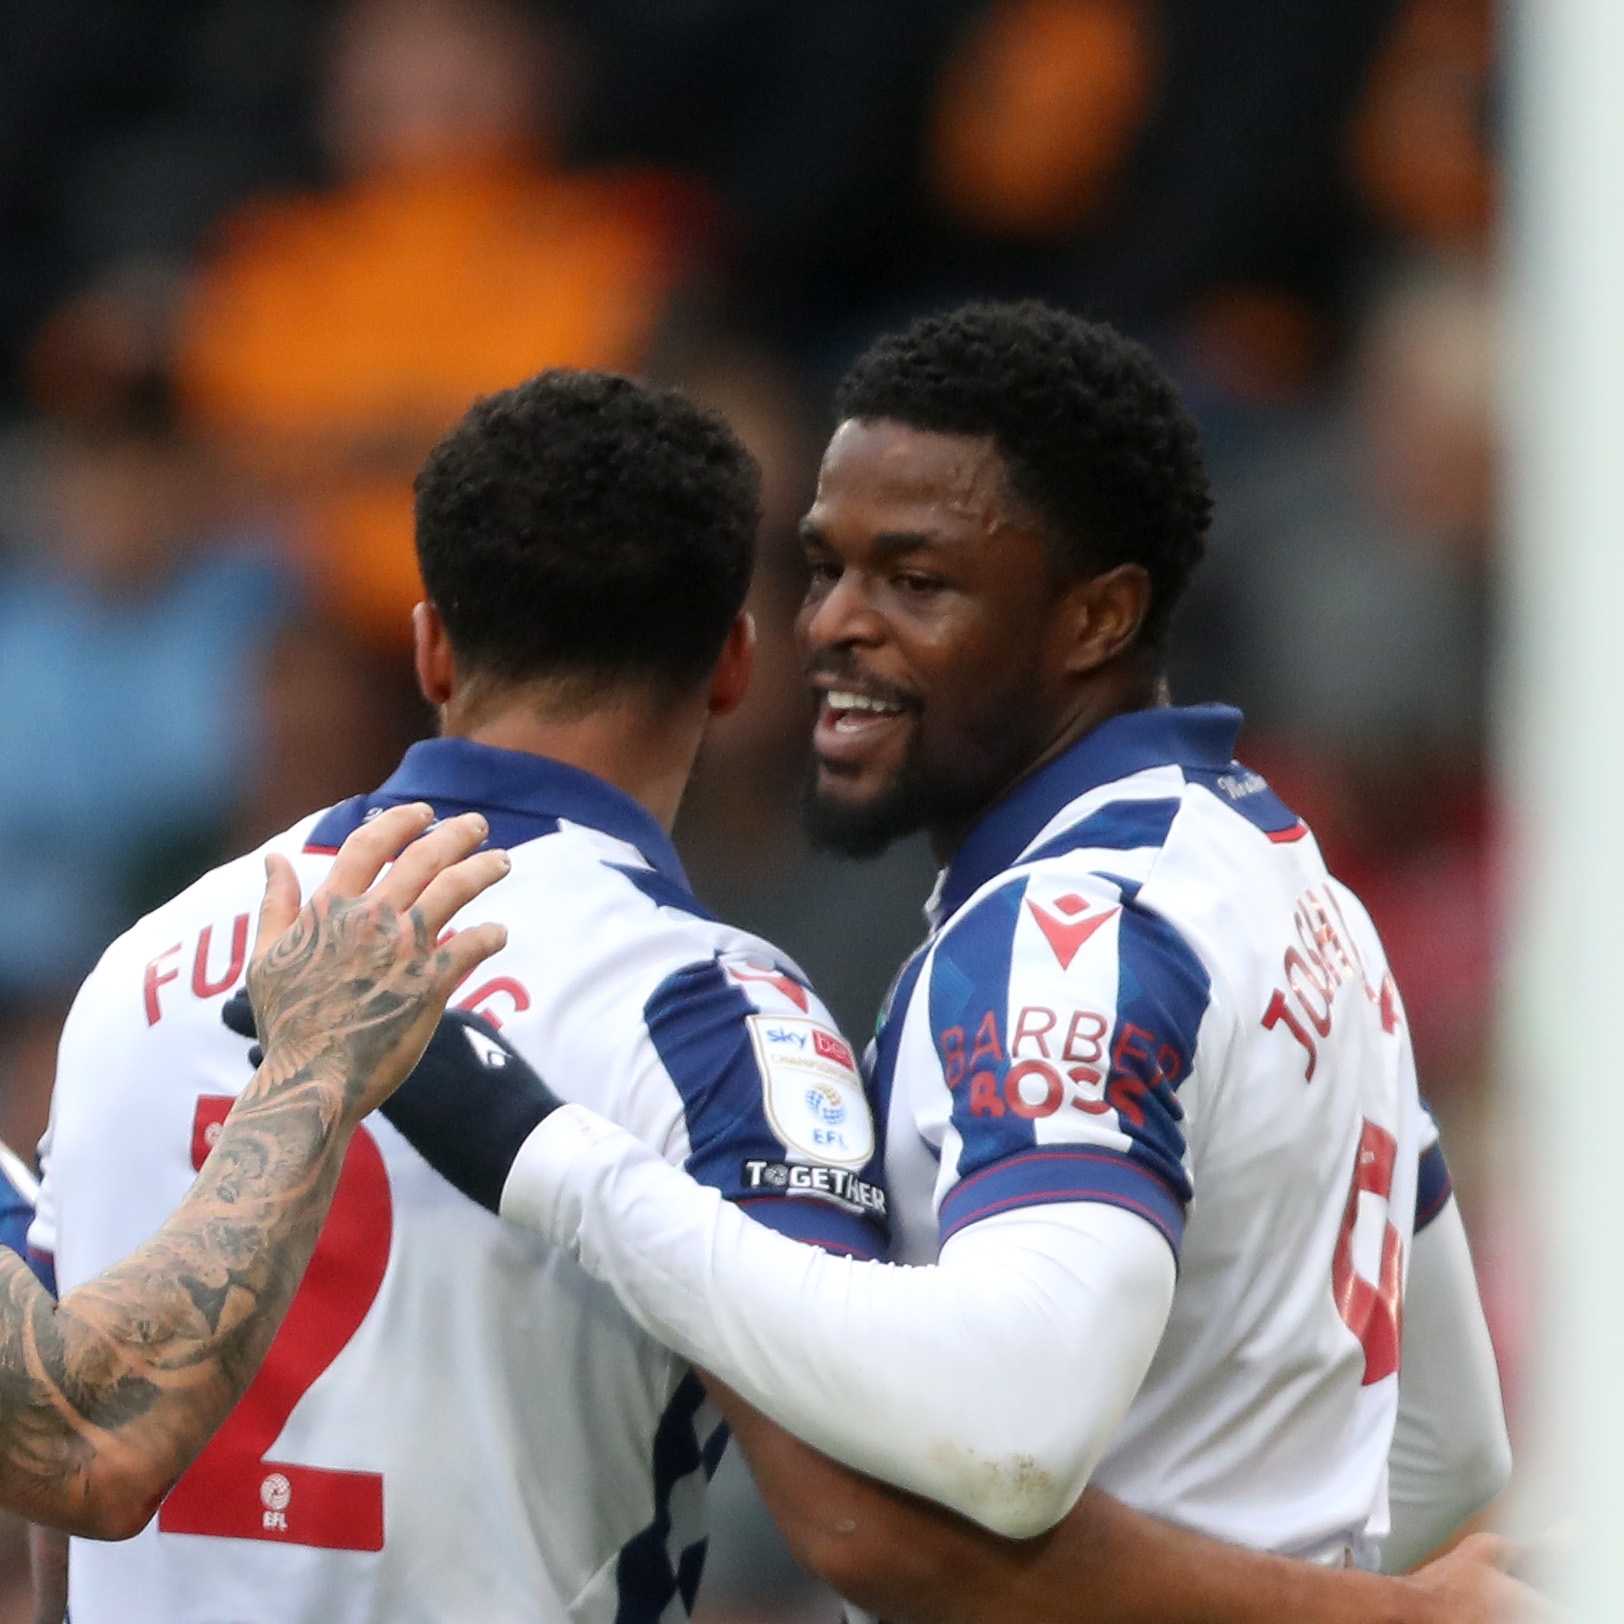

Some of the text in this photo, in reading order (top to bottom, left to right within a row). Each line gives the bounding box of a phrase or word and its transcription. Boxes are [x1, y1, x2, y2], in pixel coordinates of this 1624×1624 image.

[766, 1026, 808, 1050] sky
[813, 1128, 850, 1151] EFL
[745, 1161, 887, 1215] TOGETHER
[159, 1094, 394, 1552] 2
